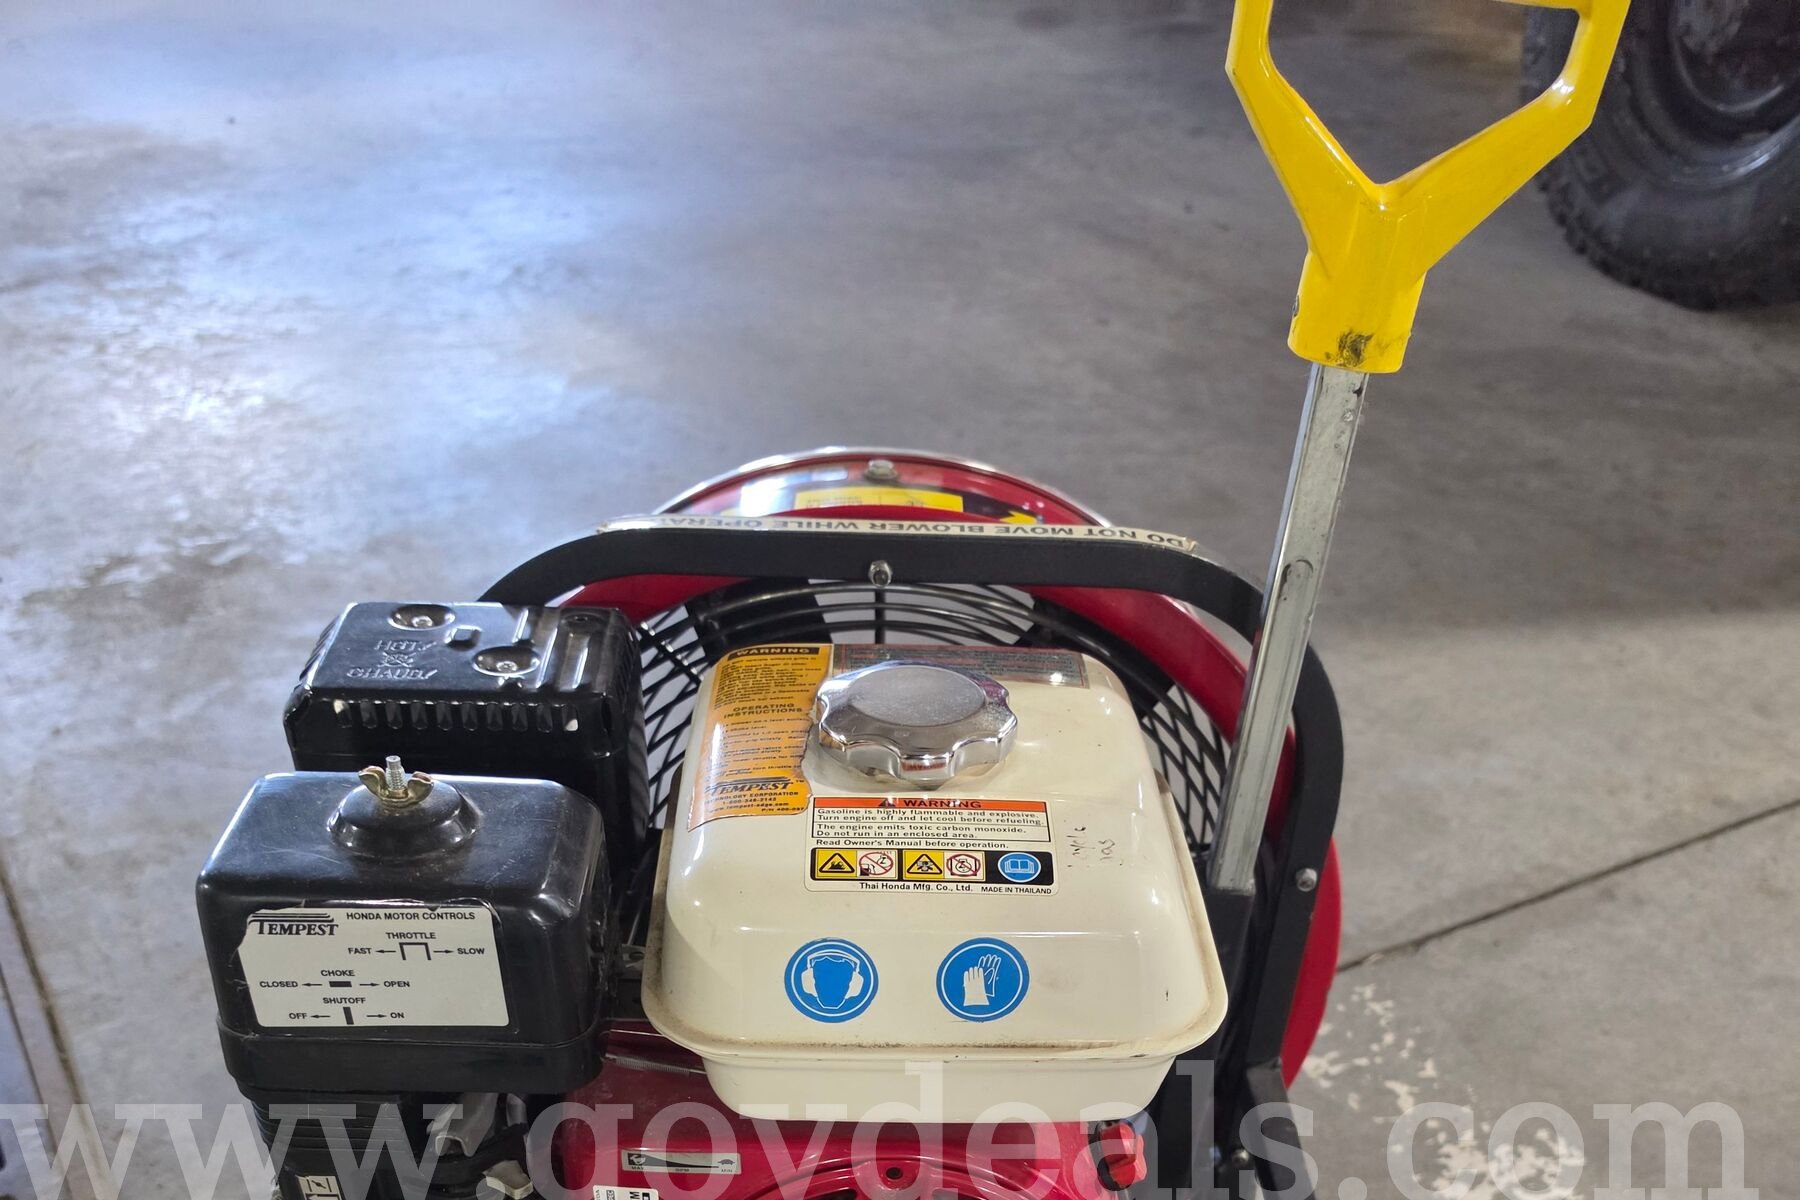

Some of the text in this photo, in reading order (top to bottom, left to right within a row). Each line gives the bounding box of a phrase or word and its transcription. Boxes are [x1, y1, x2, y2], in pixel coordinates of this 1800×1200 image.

[772, 519, 859, 530] WHILE
[869, 522, 985, 534] BLOWER
[996, 525, 1073, 536] MOVE
[1084, 526, 1137, 539] NOT
[1147, 534, 1185, 549] DO
[736, 647, 810, 656] WARNING
[733, 703, 795, 712] OPERATING
[723, 708, 803, 719] INSTRUCTIONS
[904, 799, 982, 808] WARNING
[989, 811, 1039, 819] explosive.
[996, 817, 1044, 826] refueling.
[959, 841, 1009, 849] operation.
[860, 882, 973, 892] Thai Honda Mfg. Co., Ltd.
[346, 911, 476, 921] HONDA MOTOR CONTROLS
[256, 920, 339, 936] TEMPEST
[386, 931, 437, 940] THROTTLE
[347, 947, 372, 955] FAST
[457, 947, 485, 955] SLOW
[320, 969, 355, 977] CHOKE
[259, 980, 299, 988] CLOSED
[383, 980, 411, 988] OPEN
[288, 1012, 308, 1020] OFF
[389, 1012, 405, 1020] ON
